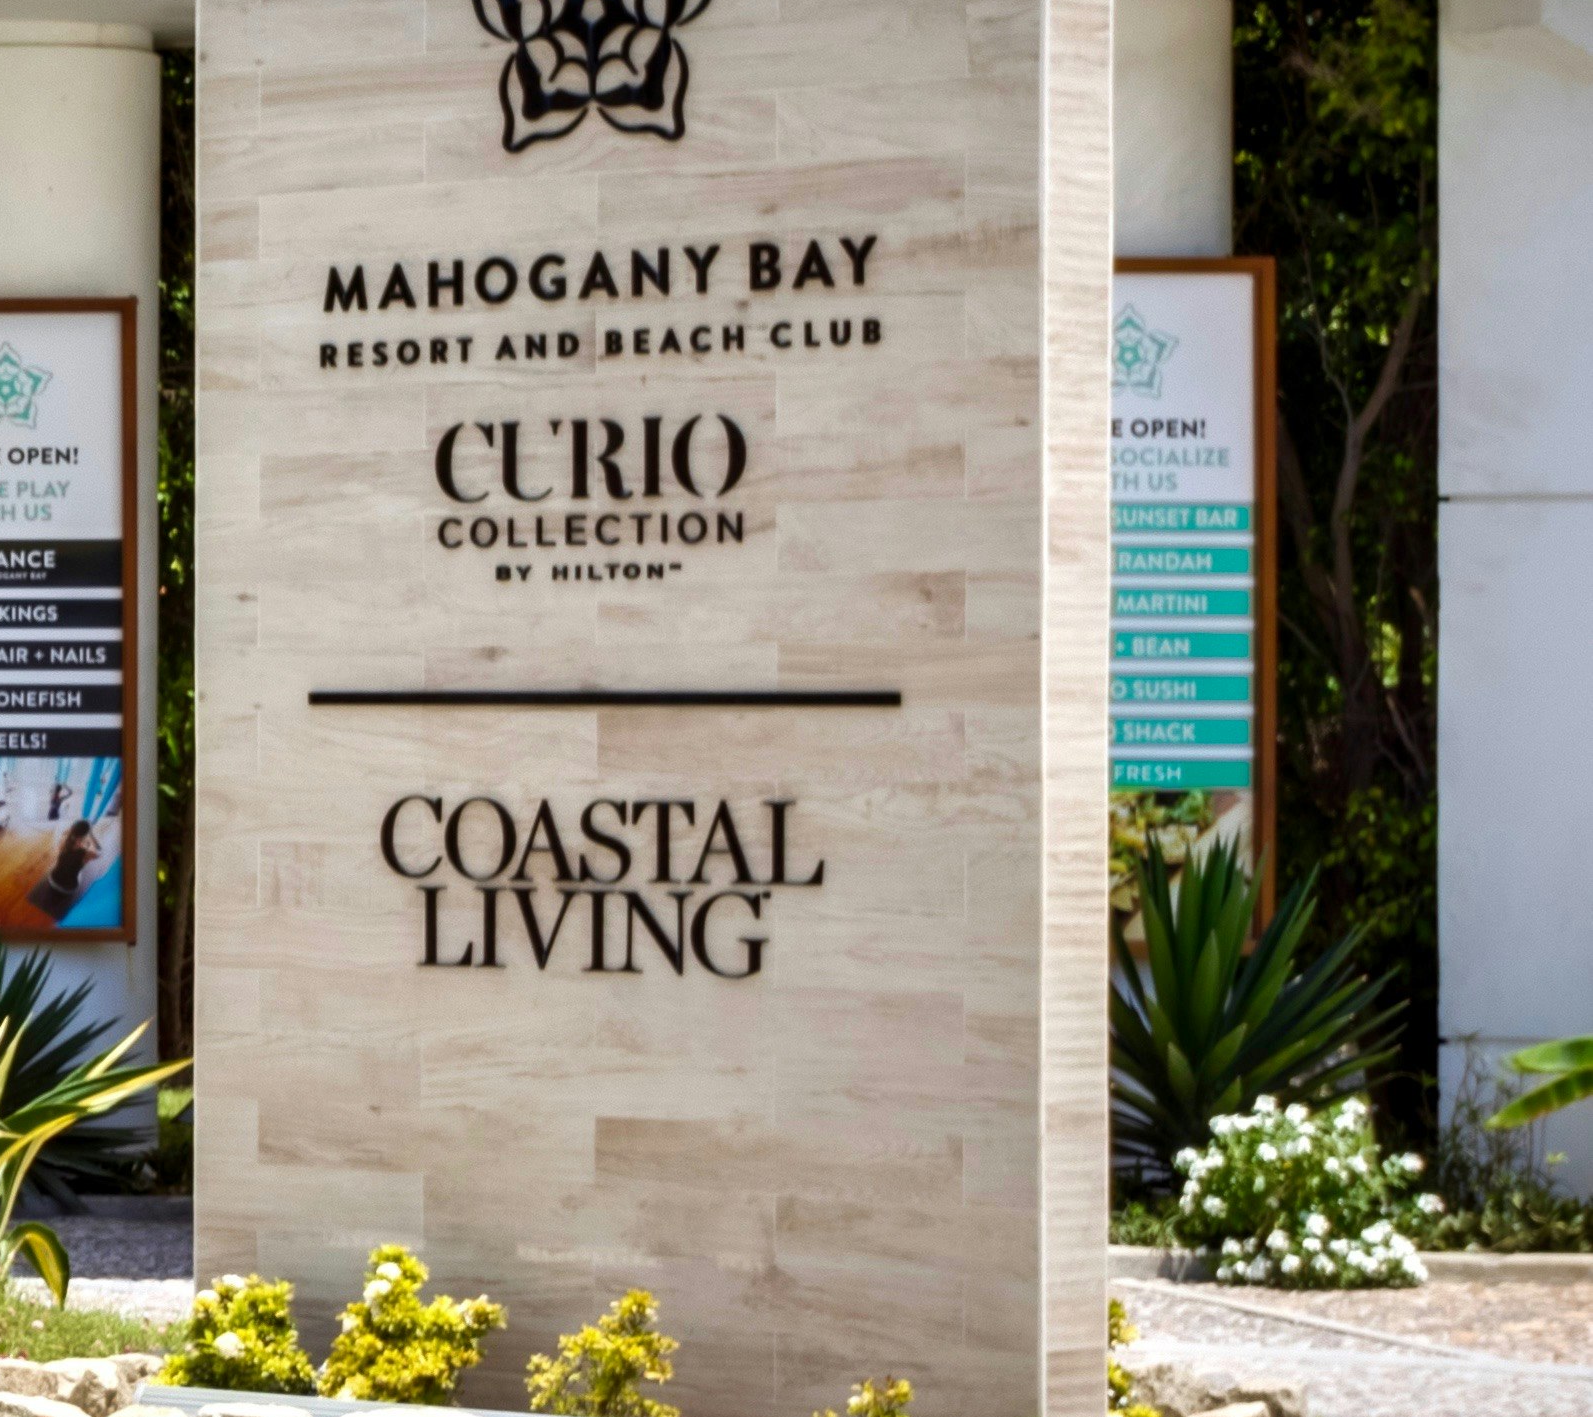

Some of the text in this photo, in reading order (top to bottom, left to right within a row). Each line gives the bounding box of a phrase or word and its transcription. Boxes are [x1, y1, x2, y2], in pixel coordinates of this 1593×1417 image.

[323, 235, 878, 313] MAHOGANY BAY
[319, 318, 882, 368] RESORT AND BEACH CLUB
[1130, 418, 1206, 439] OPEN!
[7, 446, 80, 466] OPEN!
[435, 413, 747, 504] CURIO
[16, 480, 70, 499] PLAY
[1148, 471, 1178, 492] US
[24, 503, 53, 522] US
[1195, 508, 1238, 527] BAR
[437, 512, 744, 549] COLLECTION
[1117, 552, 1214, 570] RANDAH
[495, 564, 533, 582] BY
[1116, 593, 1208, 613] MARTINI
[49, 646, 107, 665] NAILS
[1131, 636, 1191, 656] BEAN
[1132, 679, 1197, 699] SUSHI
[1123, 721, 1196, 742] SHACK
[1113, 763, 1182, 782] FRESH
[380, 794, 825, 886] COASTAL
[416, 884, 772, 980] LIVING
